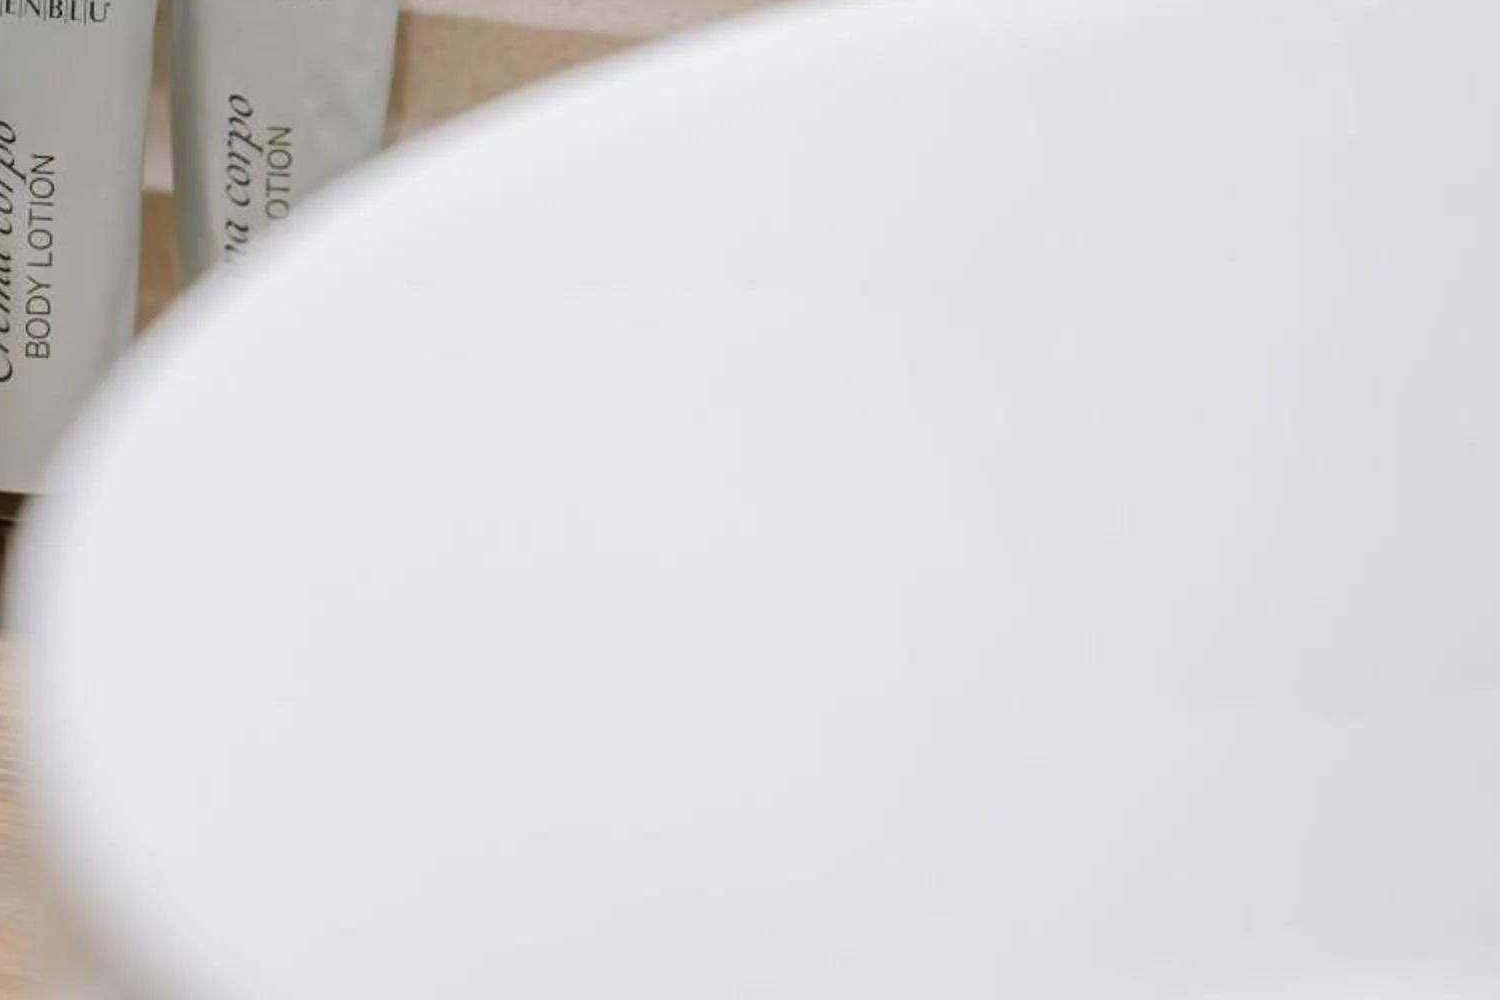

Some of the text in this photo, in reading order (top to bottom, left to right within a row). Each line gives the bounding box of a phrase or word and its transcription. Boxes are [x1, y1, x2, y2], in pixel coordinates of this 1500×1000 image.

[225, 93, 264, 208] corpo
[264, 126, 292, 220] OTION
[25, 153, 56, 359] BODY LOTION
